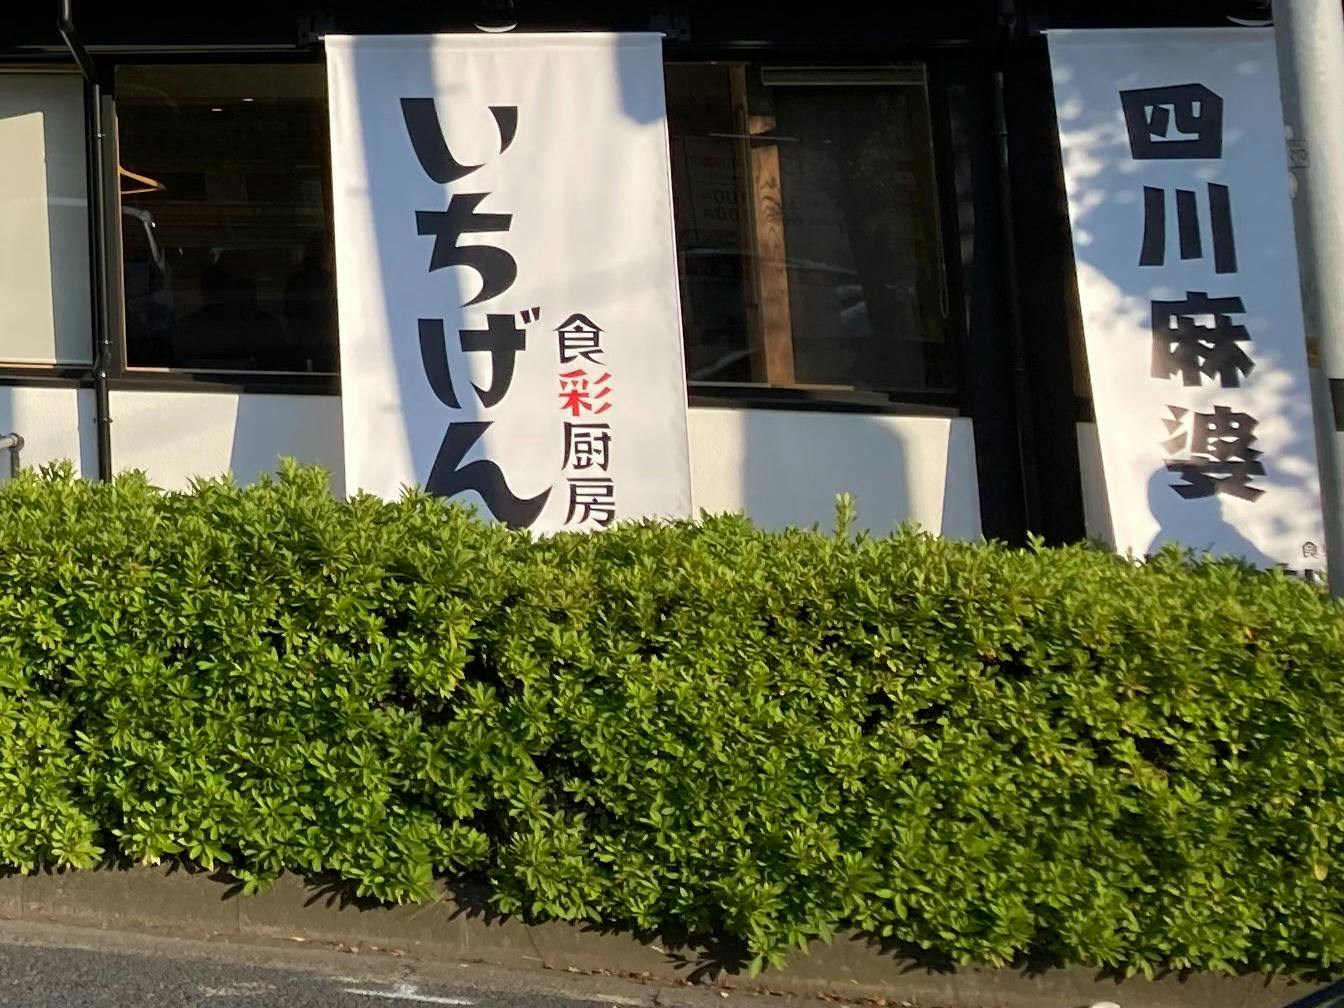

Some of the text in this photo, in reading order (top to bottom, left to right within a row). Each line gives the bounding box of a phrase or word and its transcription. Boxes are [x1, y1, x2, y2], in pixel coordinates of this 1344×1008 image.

[400, 97, 553, 530] いちげん
[552, 313, 616, 526] 食彩厨房
[1119, 83, 1267, 503] 四川麻婆
